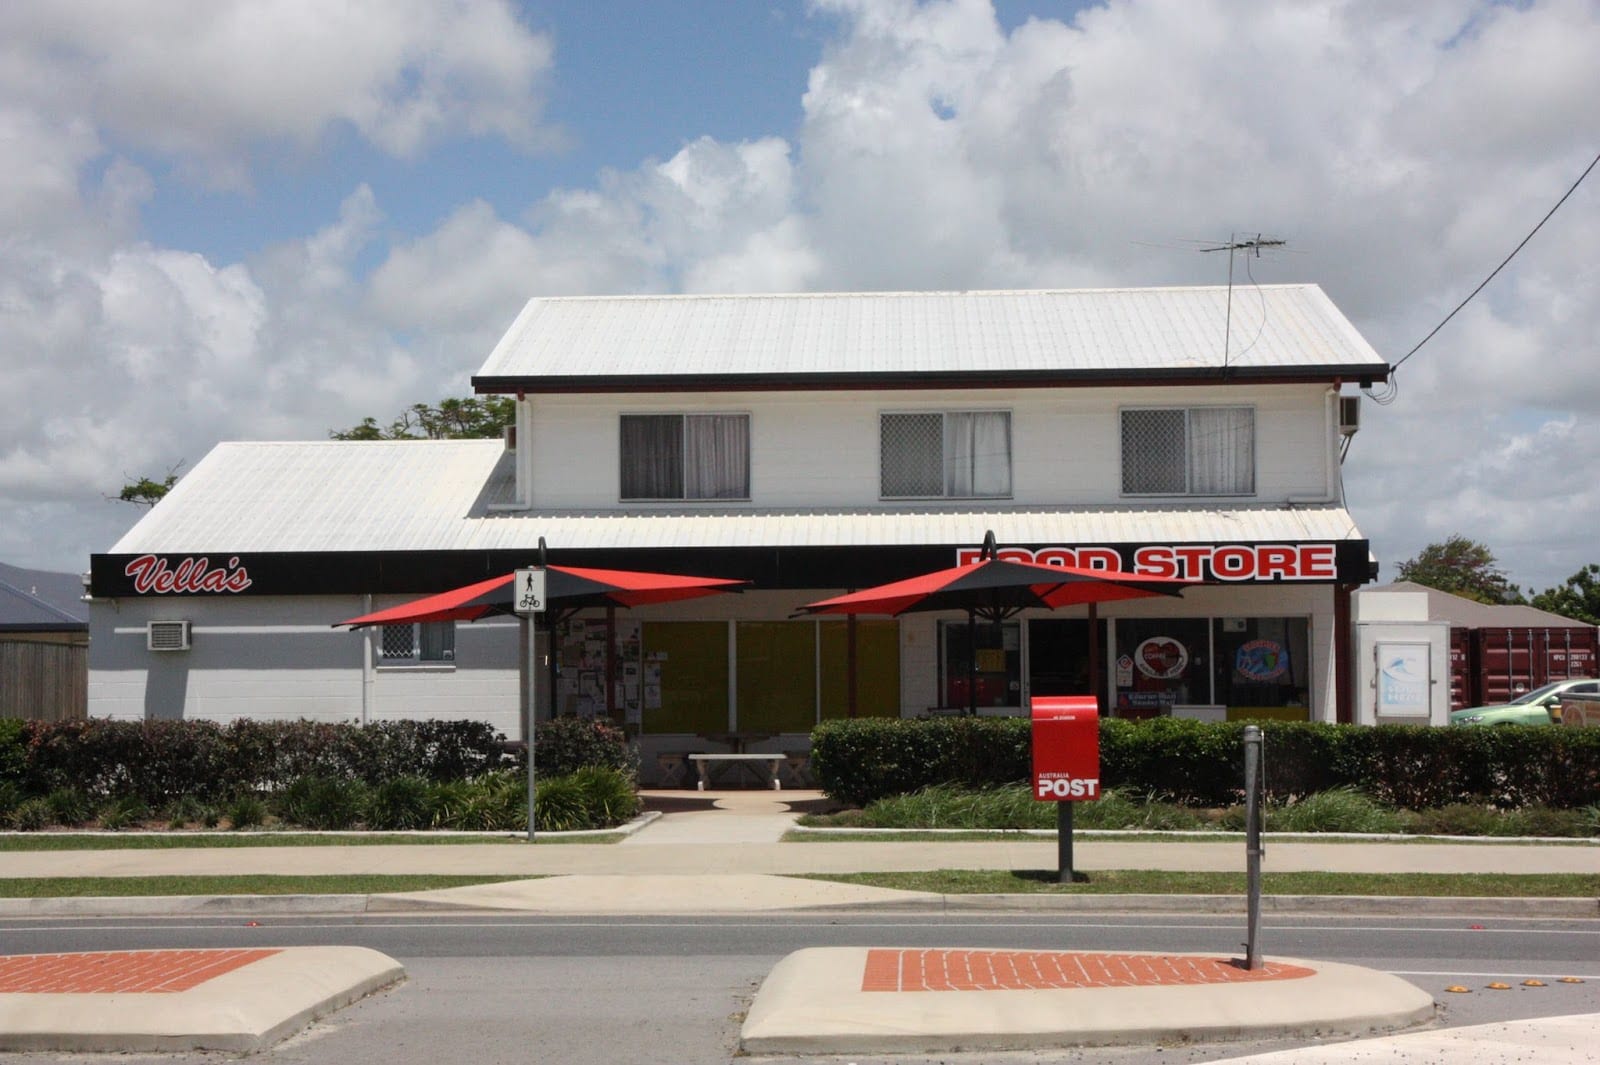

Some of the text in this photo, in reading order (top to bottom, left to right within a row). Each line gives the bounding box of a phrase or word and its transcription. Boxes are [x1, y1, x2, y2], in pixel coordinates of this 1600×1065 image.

[125, 554, 252, 593] Vella's
[1133, 544, 1337, 581] STORE
[1039, 779, 1099, 797] POST
